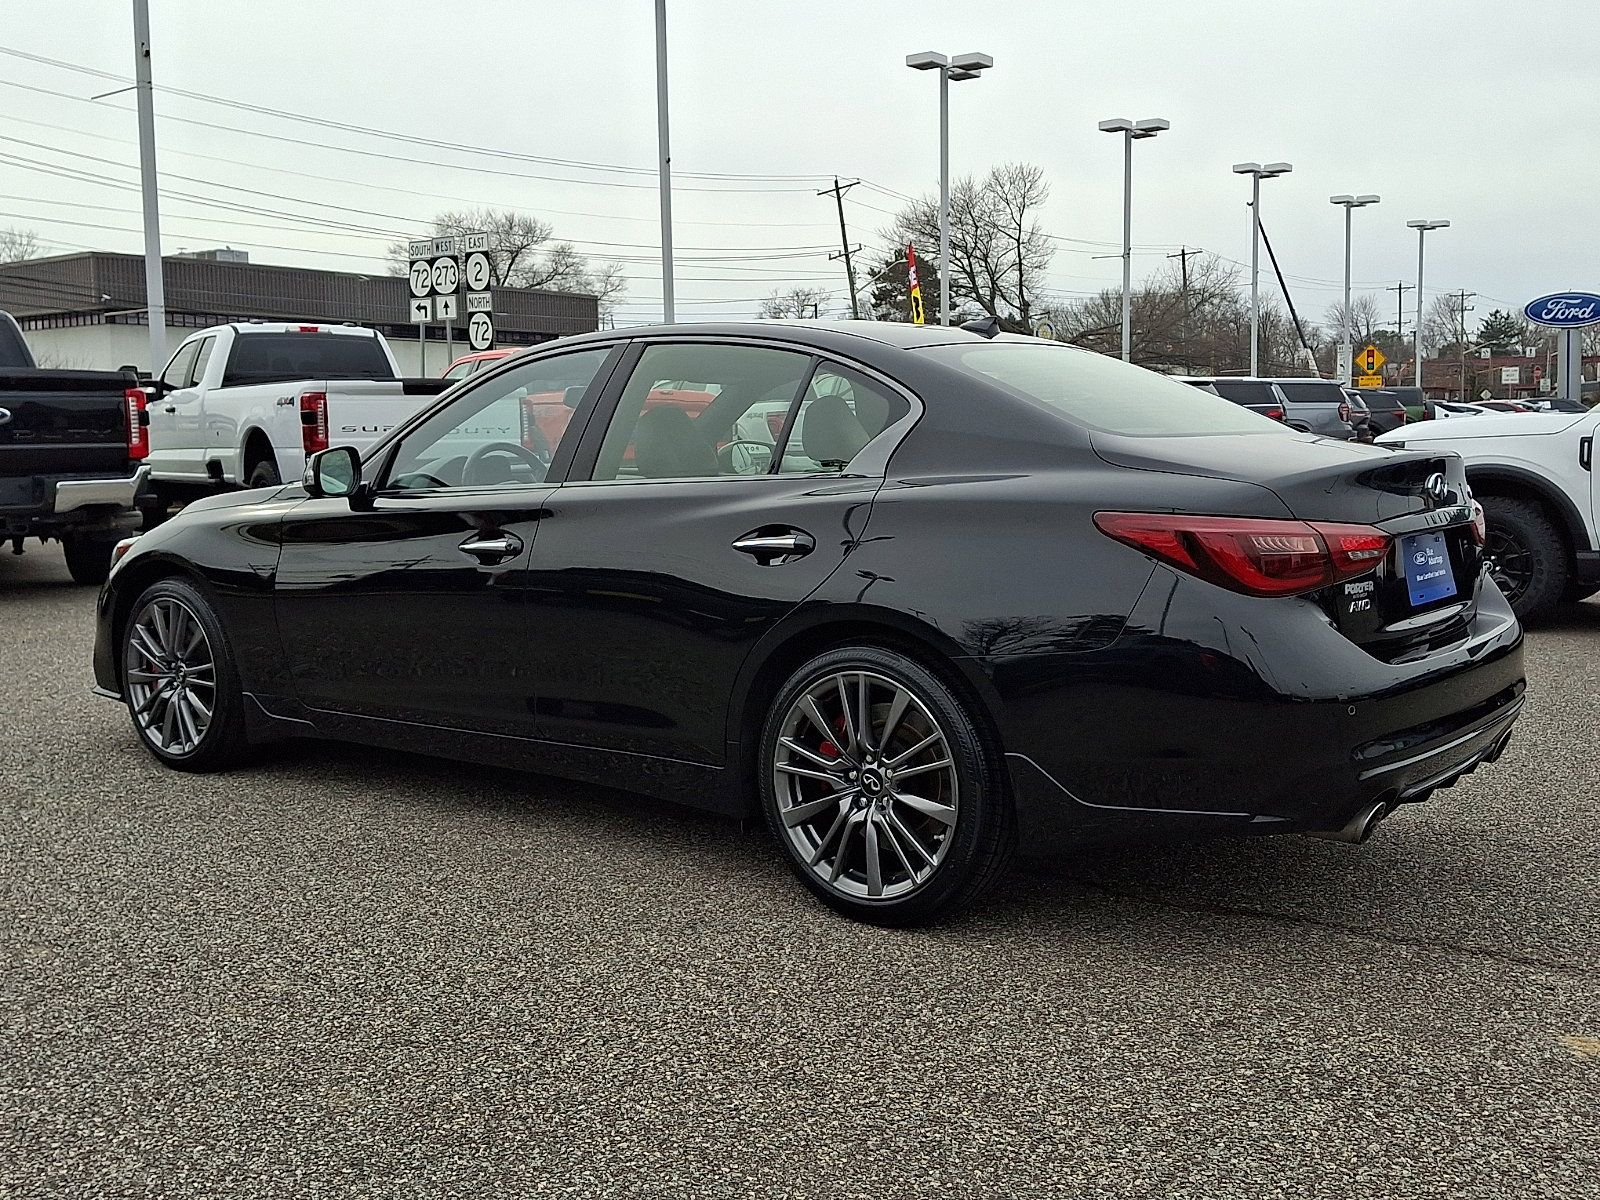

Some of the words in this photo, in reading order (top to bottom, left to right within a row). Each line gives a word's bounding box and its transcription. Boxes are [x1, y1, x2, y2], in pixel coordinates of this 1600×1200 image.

[410, 244, 431, 256] SOUTH
[435, 240, 452, 252] WEST
[468, 237, 484, 248] EAST
[412, 268, 430, 289] 72
[434, 264, 457, 286] 273
[473, 261, 483, 282] 2
[468, 296, 490, 309] NORTH
[1541, 298, 1596, 320] Ford
[471, 321, 490, 341] 72
[341, 425, 396, 433] SUP
[1344, 580, 1374, 595] PORTER
